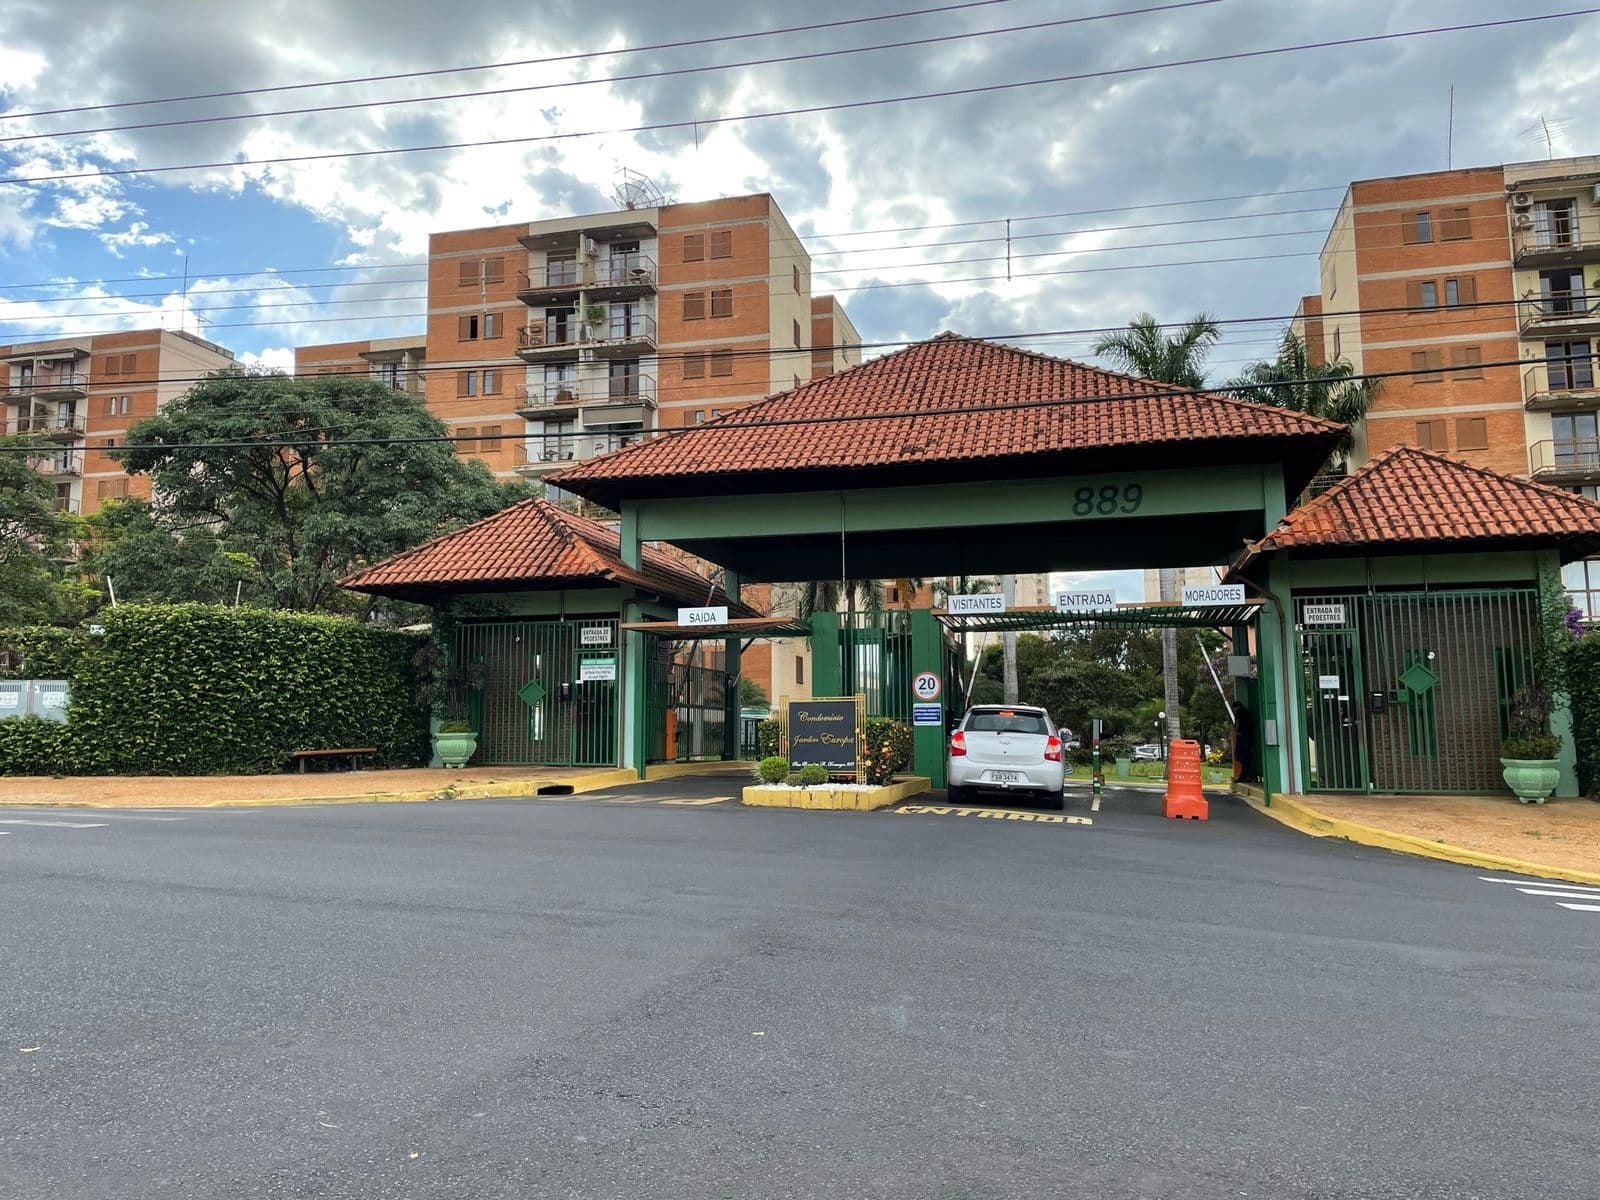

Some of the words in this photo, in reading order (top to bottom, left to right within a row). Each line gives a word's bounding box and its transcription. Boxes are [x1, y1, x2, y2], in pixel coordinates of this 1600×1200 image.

[1072, 484, 1143, 516] 889
[1060, 593, 1113, 606] ENTRADA
[1185, 589, 1241, 602] MORADORES
[952, 597, 1002, 610] VISITANTES
[1334, 606, 1342, 614] DE
[689, 610, 716, 623] SAÍDA
[1308, 614, 1341, 622] PEDESTRES
[918, 677, 936, 690] 20
[820, 732, 855, 748] Europa
[894, 806, 1093, 825] ENTRADA
